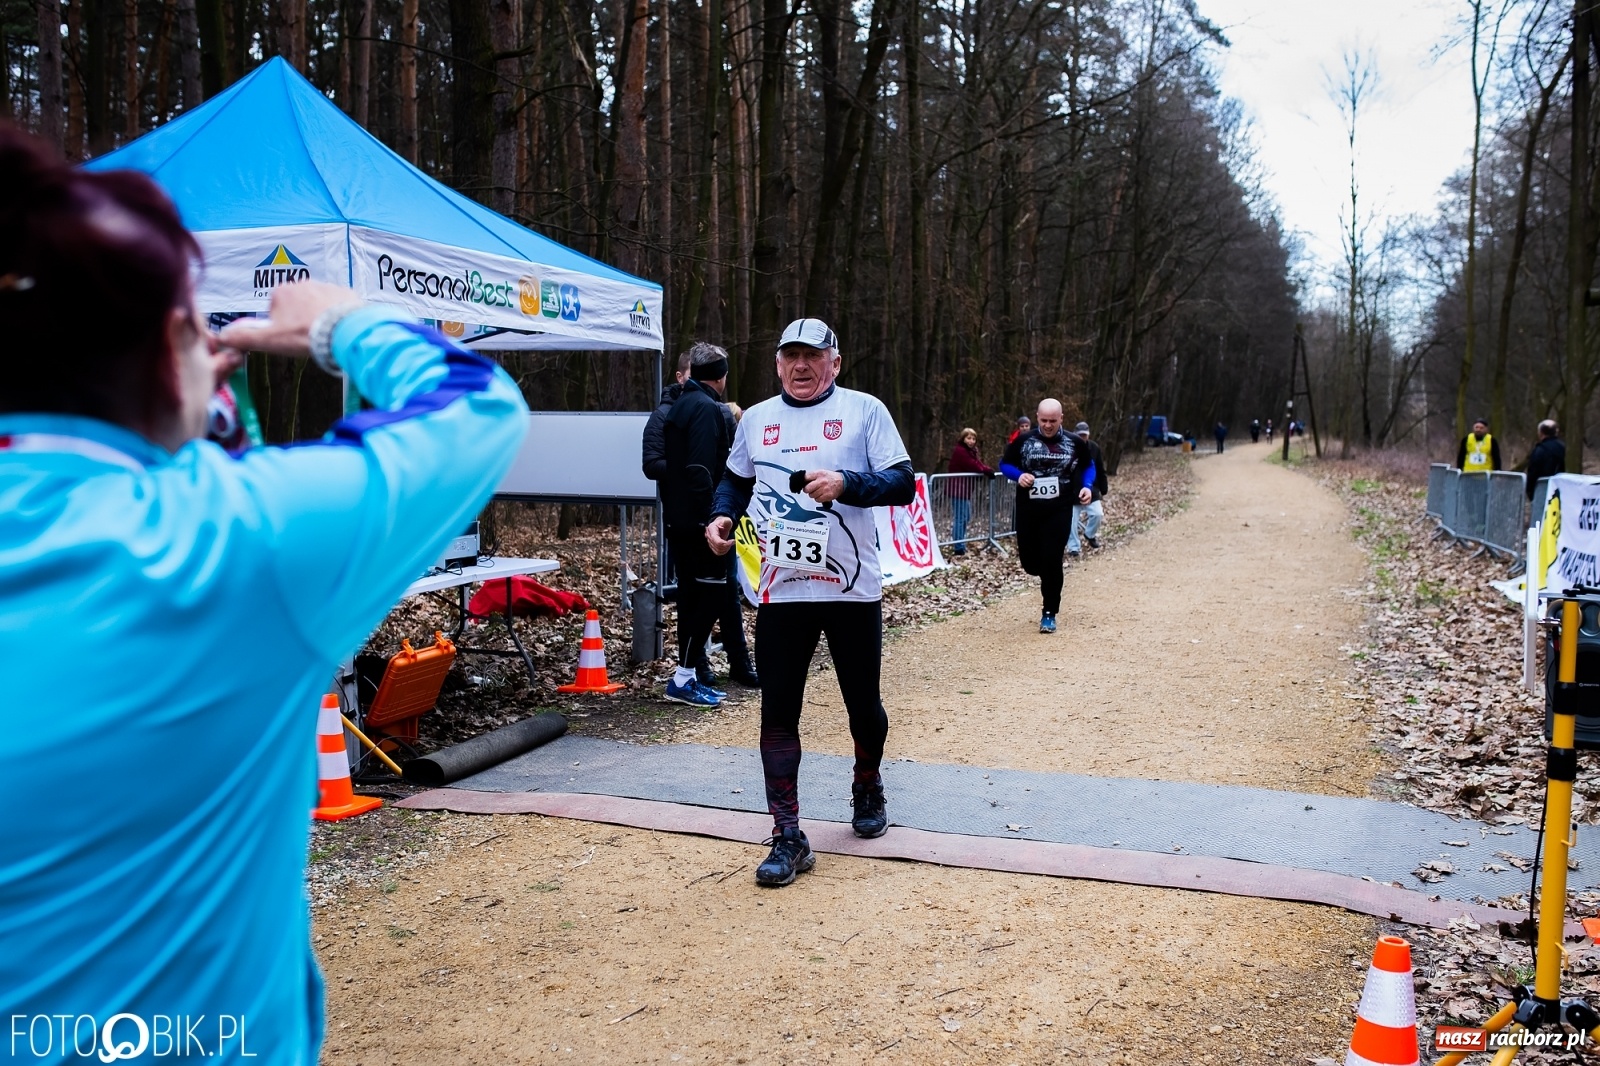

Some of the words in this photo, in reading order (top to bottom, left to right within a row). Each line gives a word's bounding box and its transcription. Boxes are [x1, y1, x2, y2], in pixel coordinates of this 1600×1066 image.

[253, 268, 310, 288] MITKO
[378, 253, 514, 308] PersonalBest
[629, 313, 651, 331] MITKO
[1031, 485, 1057, 496] 203
[786, 526, 827, 536] www.personalbest.pl
[770, 535, 822, 564] 133
